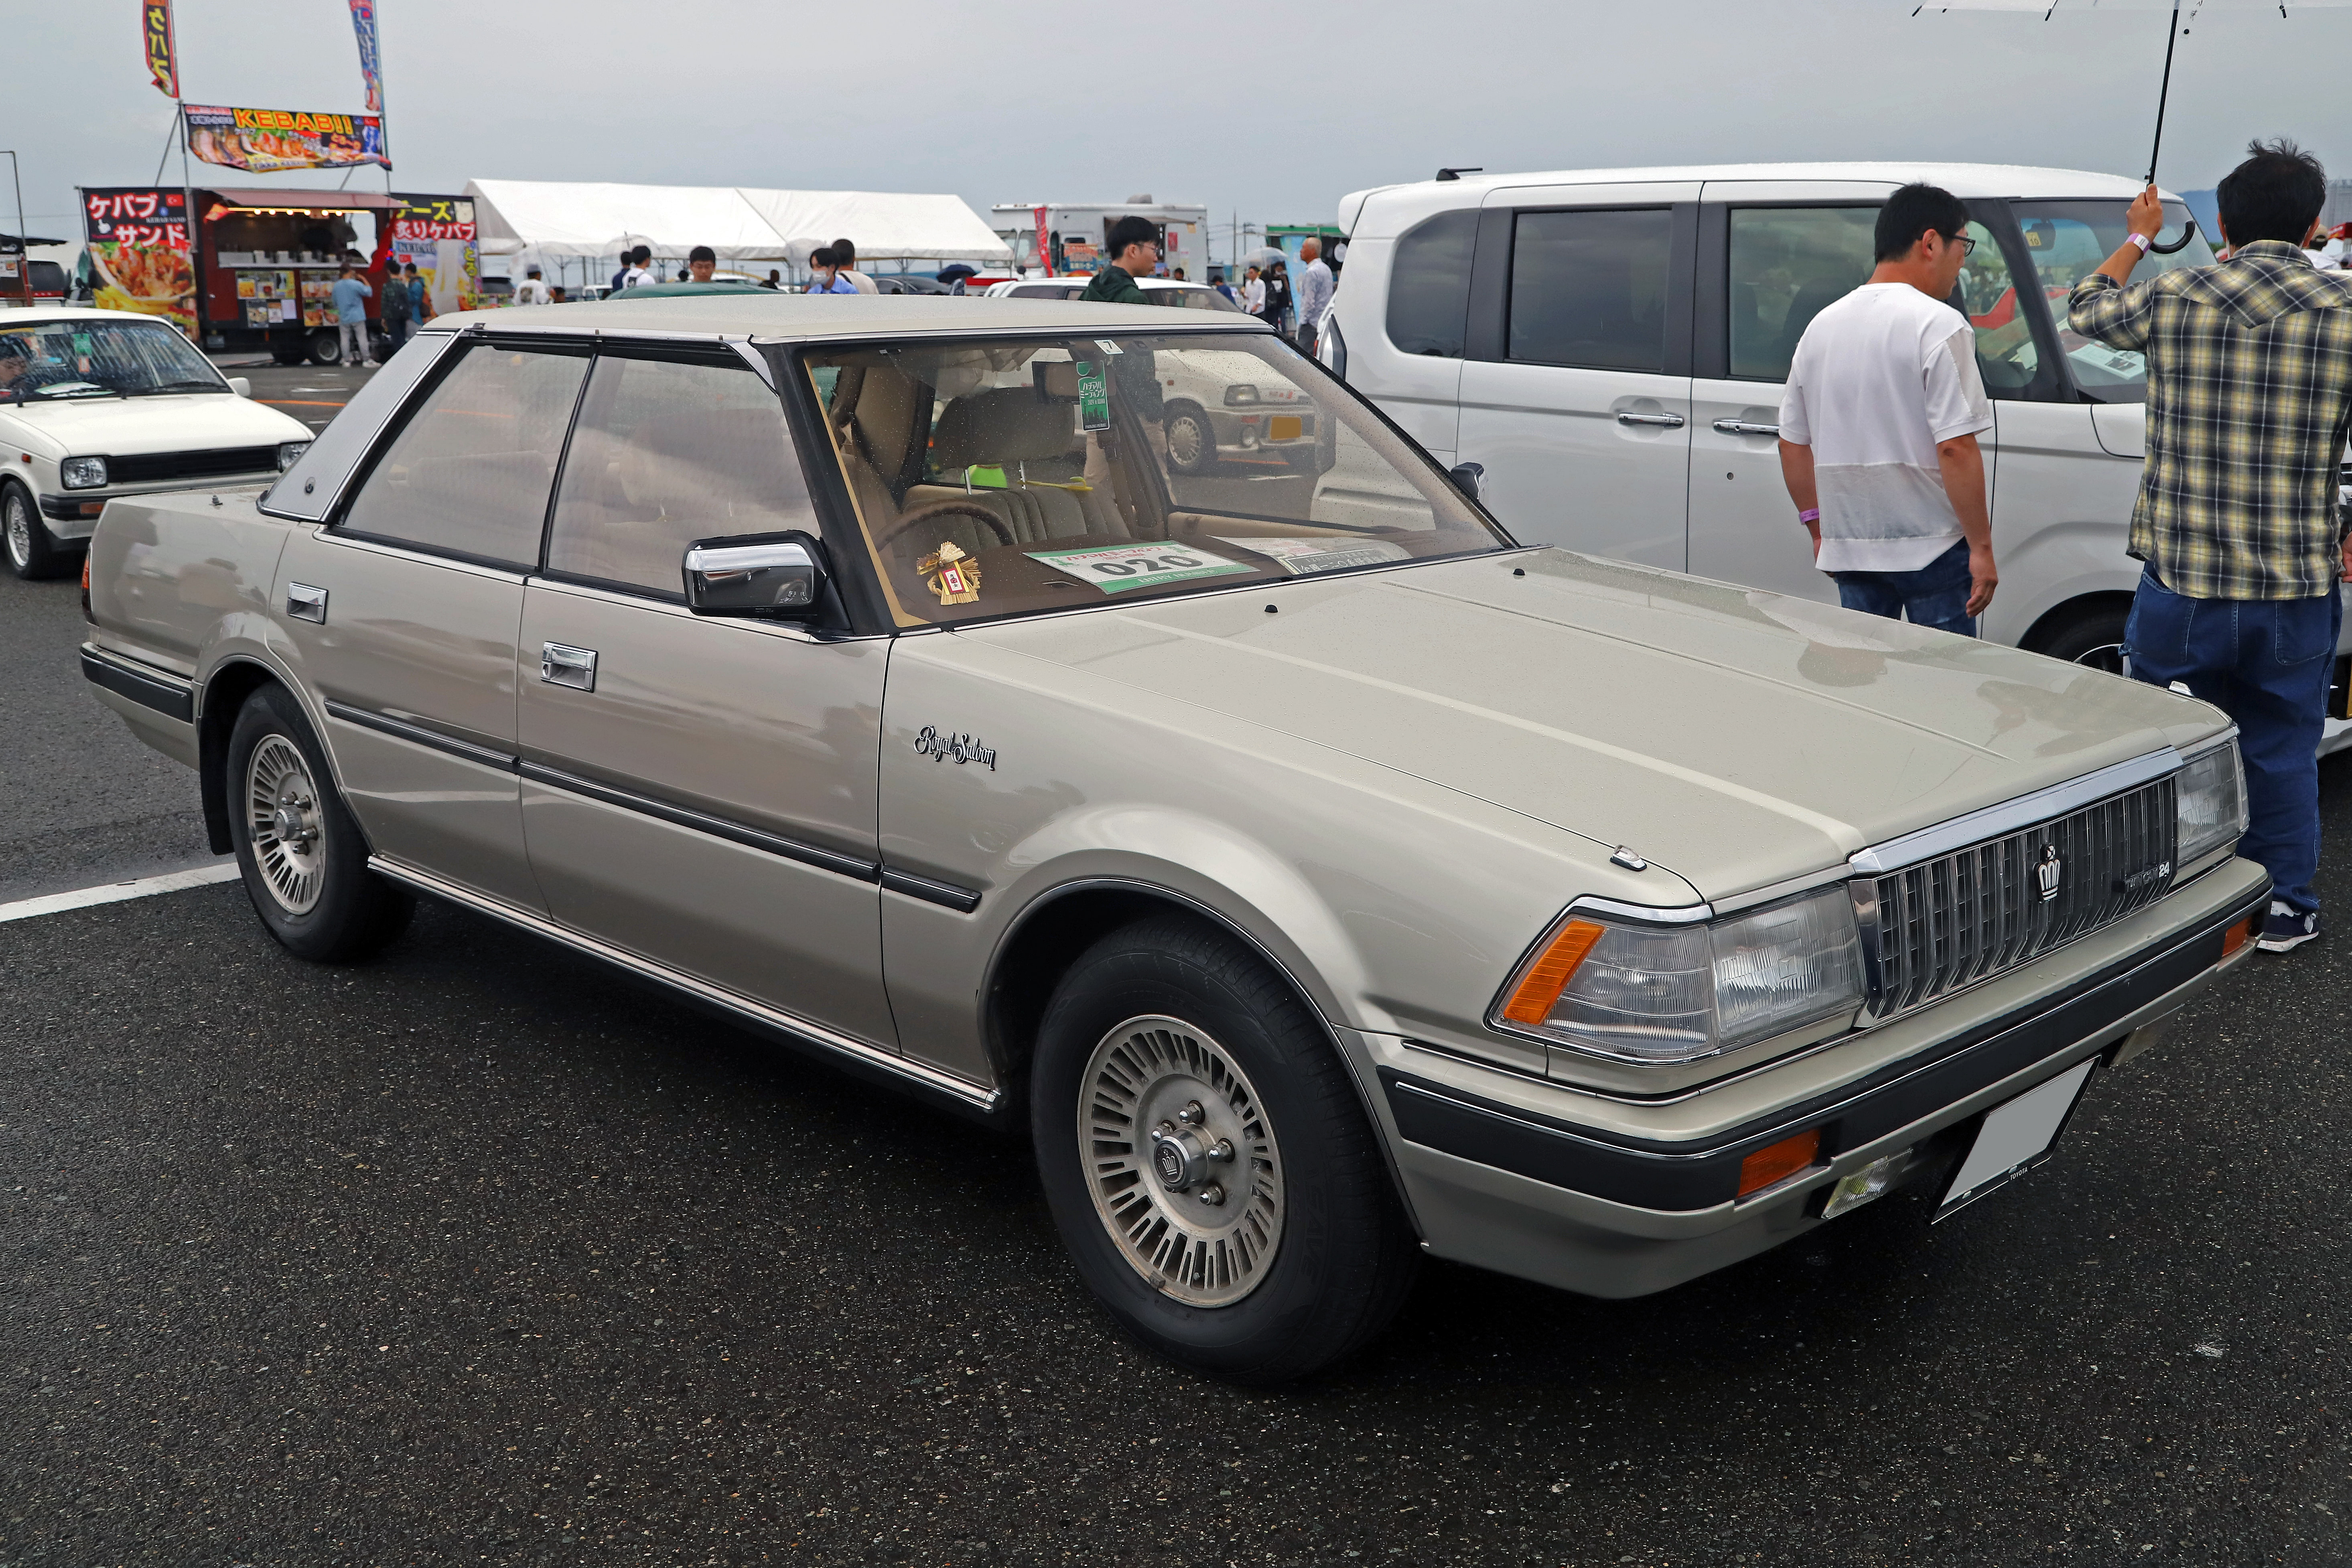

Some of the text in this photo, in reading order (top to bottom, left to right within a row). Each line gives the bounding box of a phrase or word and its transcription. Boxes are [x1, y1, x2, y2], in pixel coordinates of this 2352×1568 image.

[232, 108, 353, 135] KEBAB!!
[87, 191, 159, 220] ケバブ
[114, 223, 187, 248] サンド
[394, 219, 477, 241] 炙りケバブ
[1083, 381, 1102, 390] ハチマル
[1091, 555, 1203, 576] 020
[913, 725, 996, 771] Royal Saloon
[2158, 861, 2170, 878] 24
[2010, 1166, 2028, 1181] TOYOTA
